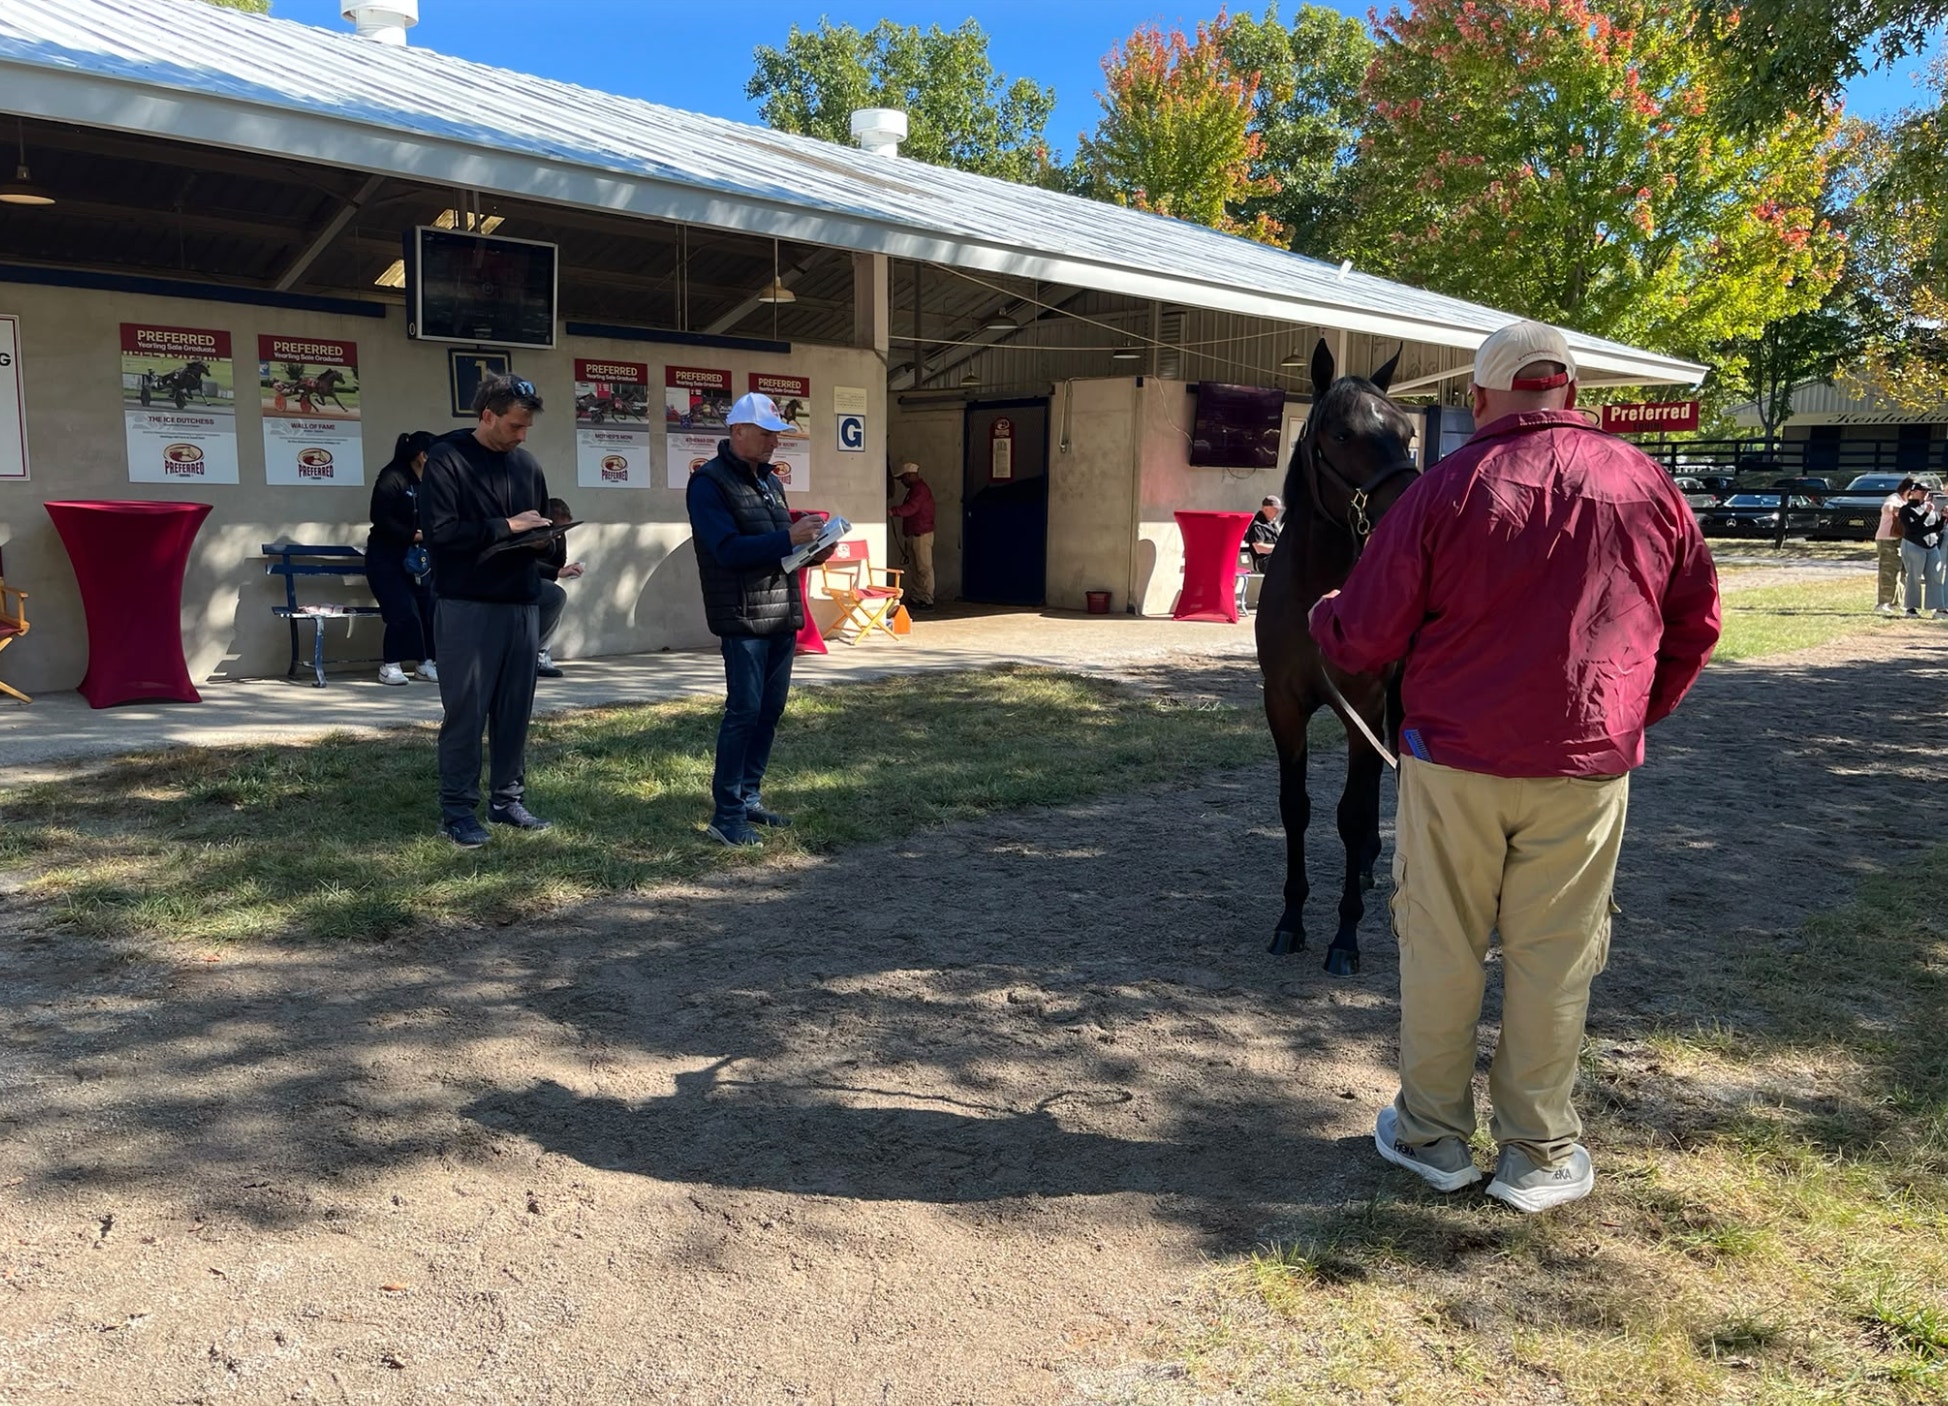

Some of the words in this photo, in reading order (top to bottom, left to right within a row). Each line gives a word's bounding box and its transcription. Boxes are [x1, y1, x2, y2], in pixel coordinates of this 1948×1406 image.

[137, 330, 215, 346] PREFERRED
[138, 342, 166, 351] Yearling
[183, 345, 216, 353] Graduate
[274, 341, 343, 356] PREFERRED
[274, 352, 300, 360] Yearling
[586, 364, 638, 376] PREFERRED
[676, 371, 723, 383] PREFERRED
[758, 378, 802, 389] PREFERRED
[1610, 403, 1690, 421] Preferred
[176, 417, 214, 425] DUTCHESS
[841, 418, 862, 447] G
[165, 460, 205, 475] PREFERRED
[298, 464, 334, 478] PREFERRED
[601, 469, 628, 481] PREFERRED
